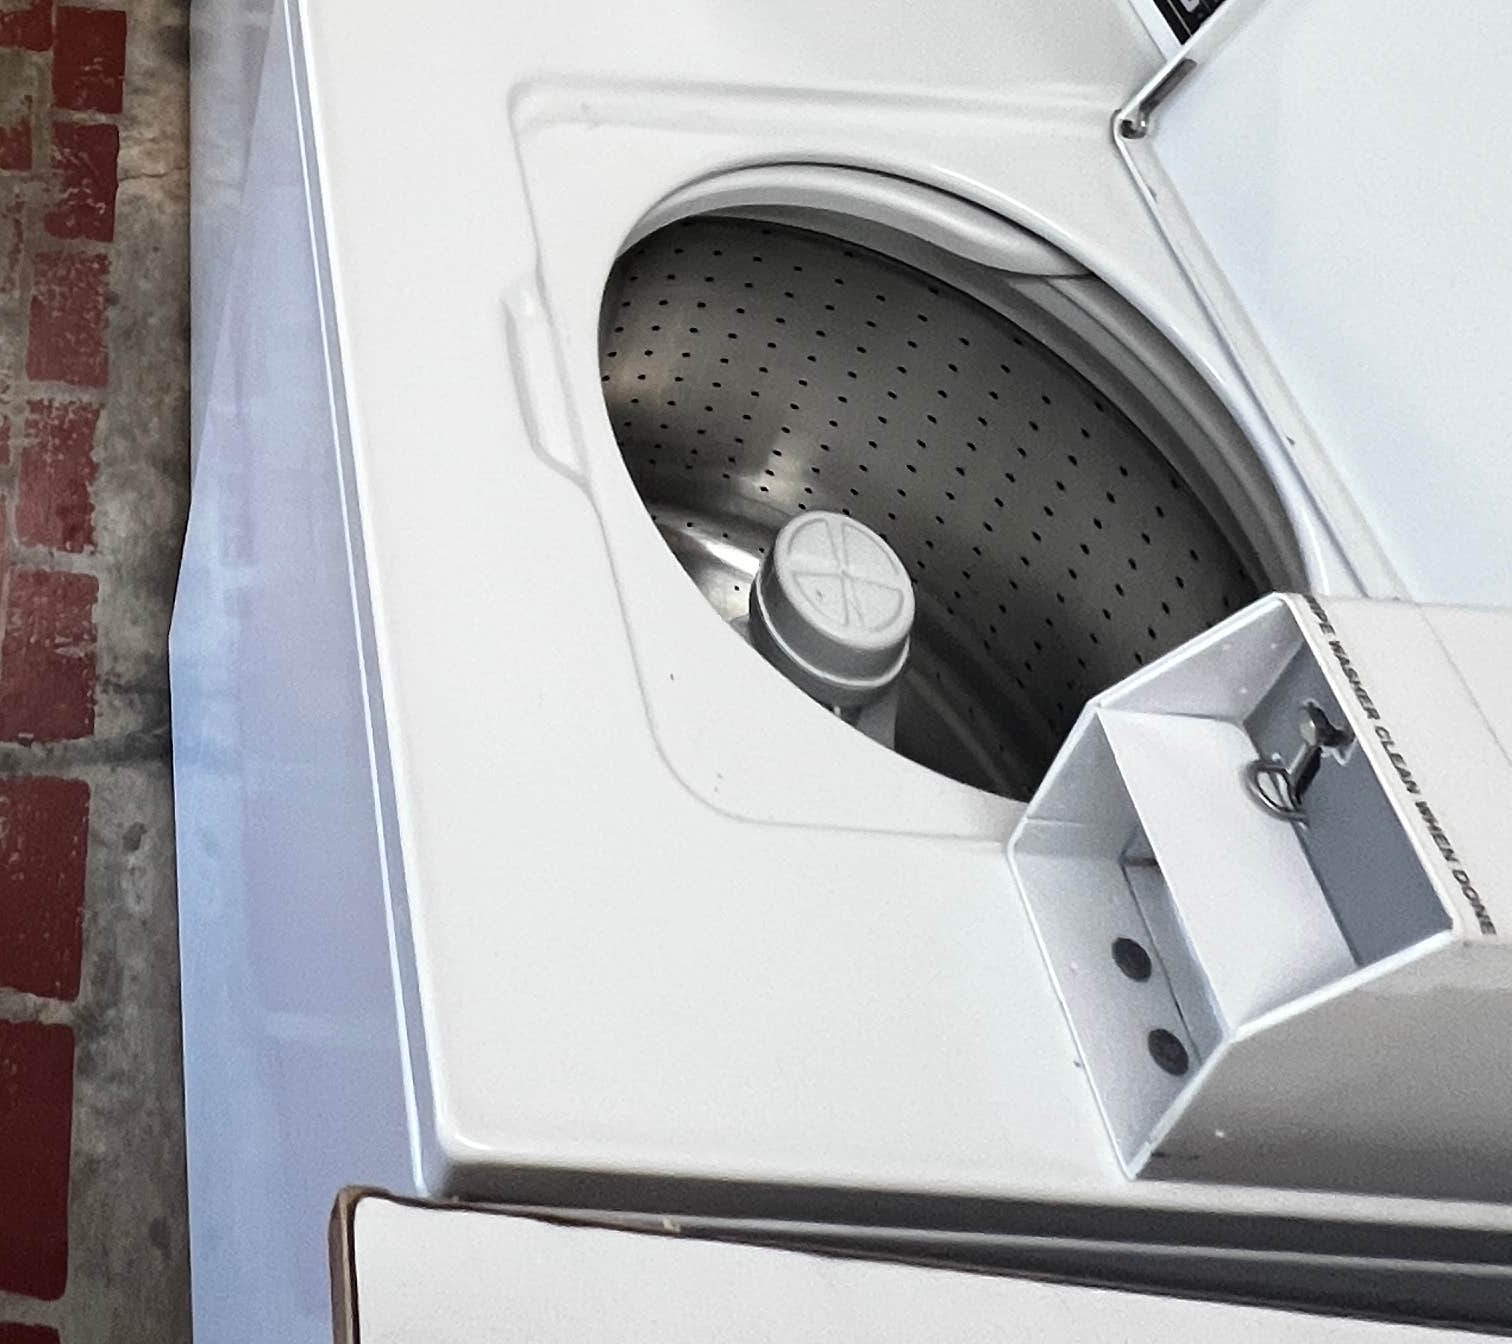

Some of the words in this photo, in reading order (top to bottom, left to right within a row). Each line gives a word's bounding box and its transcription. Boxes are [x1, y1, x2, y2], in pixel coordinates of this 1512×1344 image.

[1328, 640, 1381, 720] WASHER
[1374, 724, 1422, 795] CLEAN
[1415, 801, 1459, 862] WHEN
[1452, 868, 1497, 936] DONE
